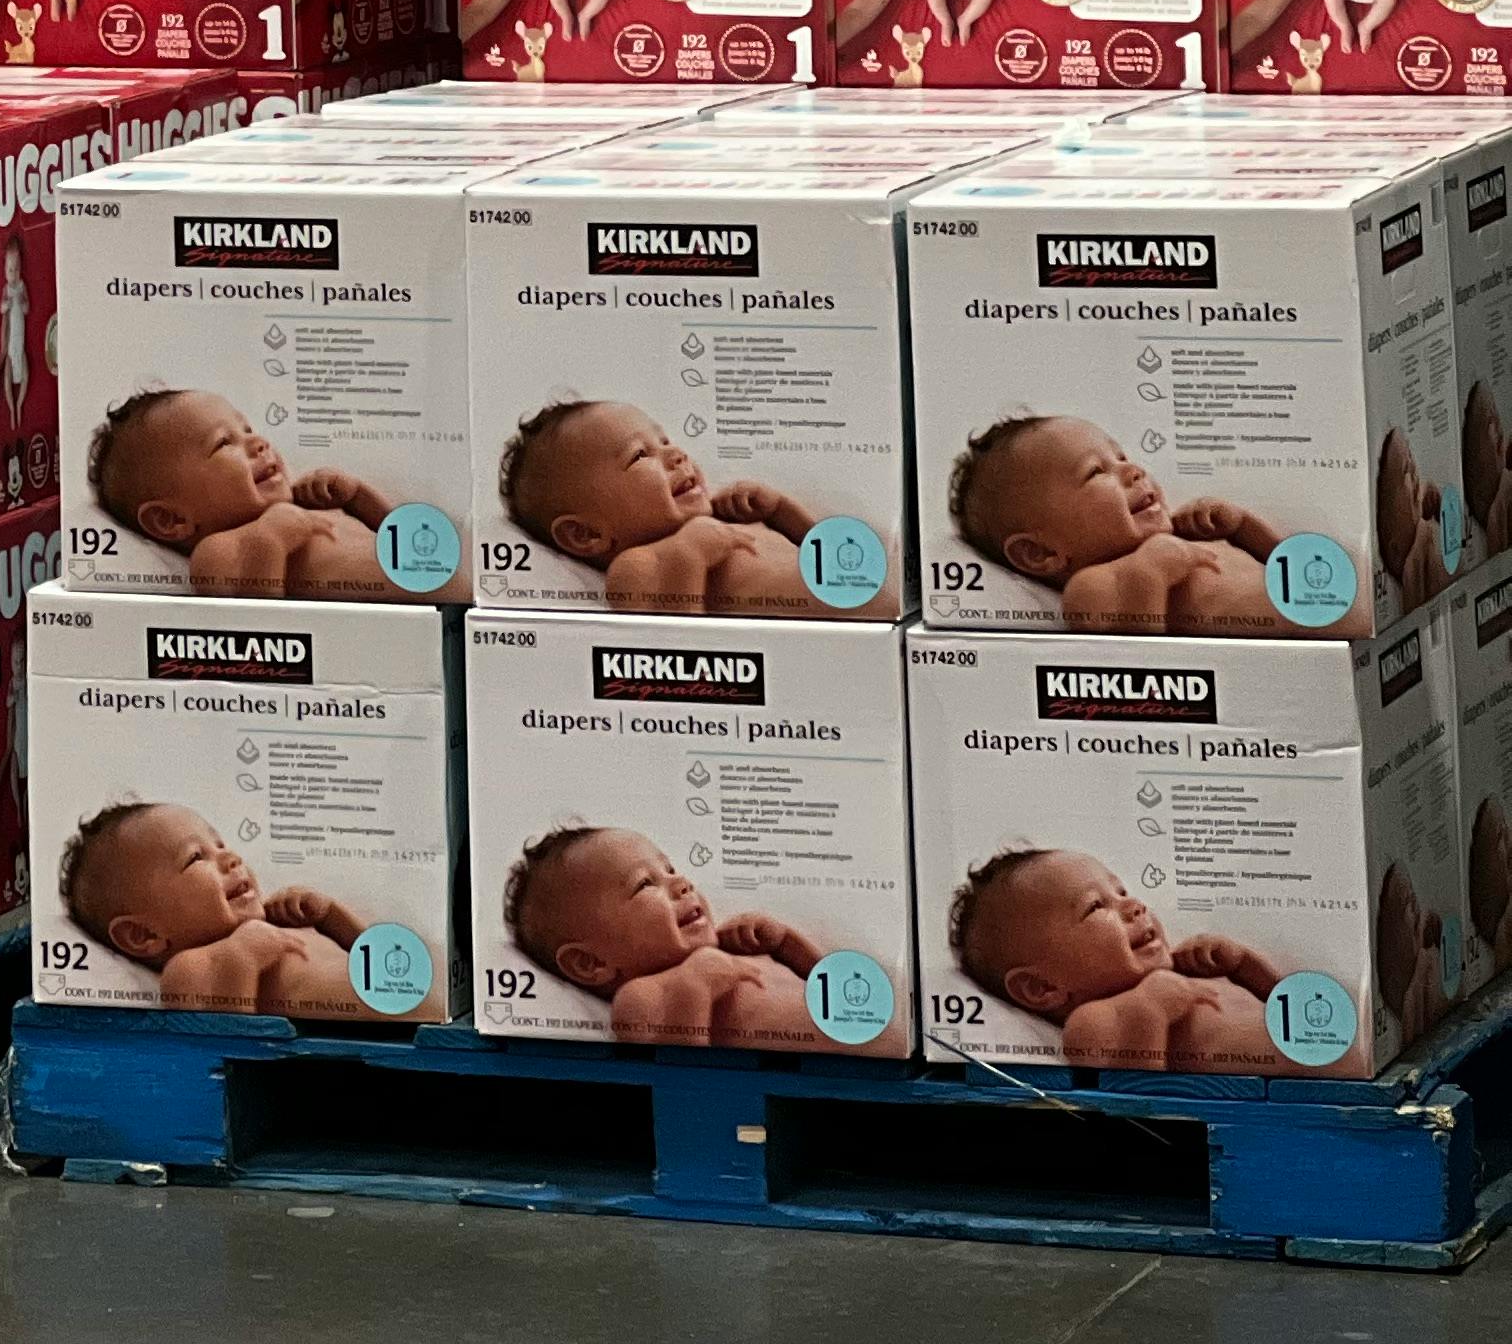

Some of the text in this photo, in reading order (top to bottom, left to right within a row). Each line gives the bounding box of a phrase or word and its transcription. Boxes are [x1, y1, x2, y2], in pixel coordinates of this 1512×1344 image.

[680, 34, 706, 49] 192
[183, 222, 332, 249] KIRKLAND
[1047, 239, 1208, 267] KIRKLAND
[107, 278, 411, 305] diapers couches pañales
[69, 528, 118, 556] 192
[1045, 672, 1208, 700] KIRKLAND
[964, 731, 1297, 761] diapers couches pañales
[931, 995, 985, 1024] 192
[1276, 993, 1291, 1043] 1
